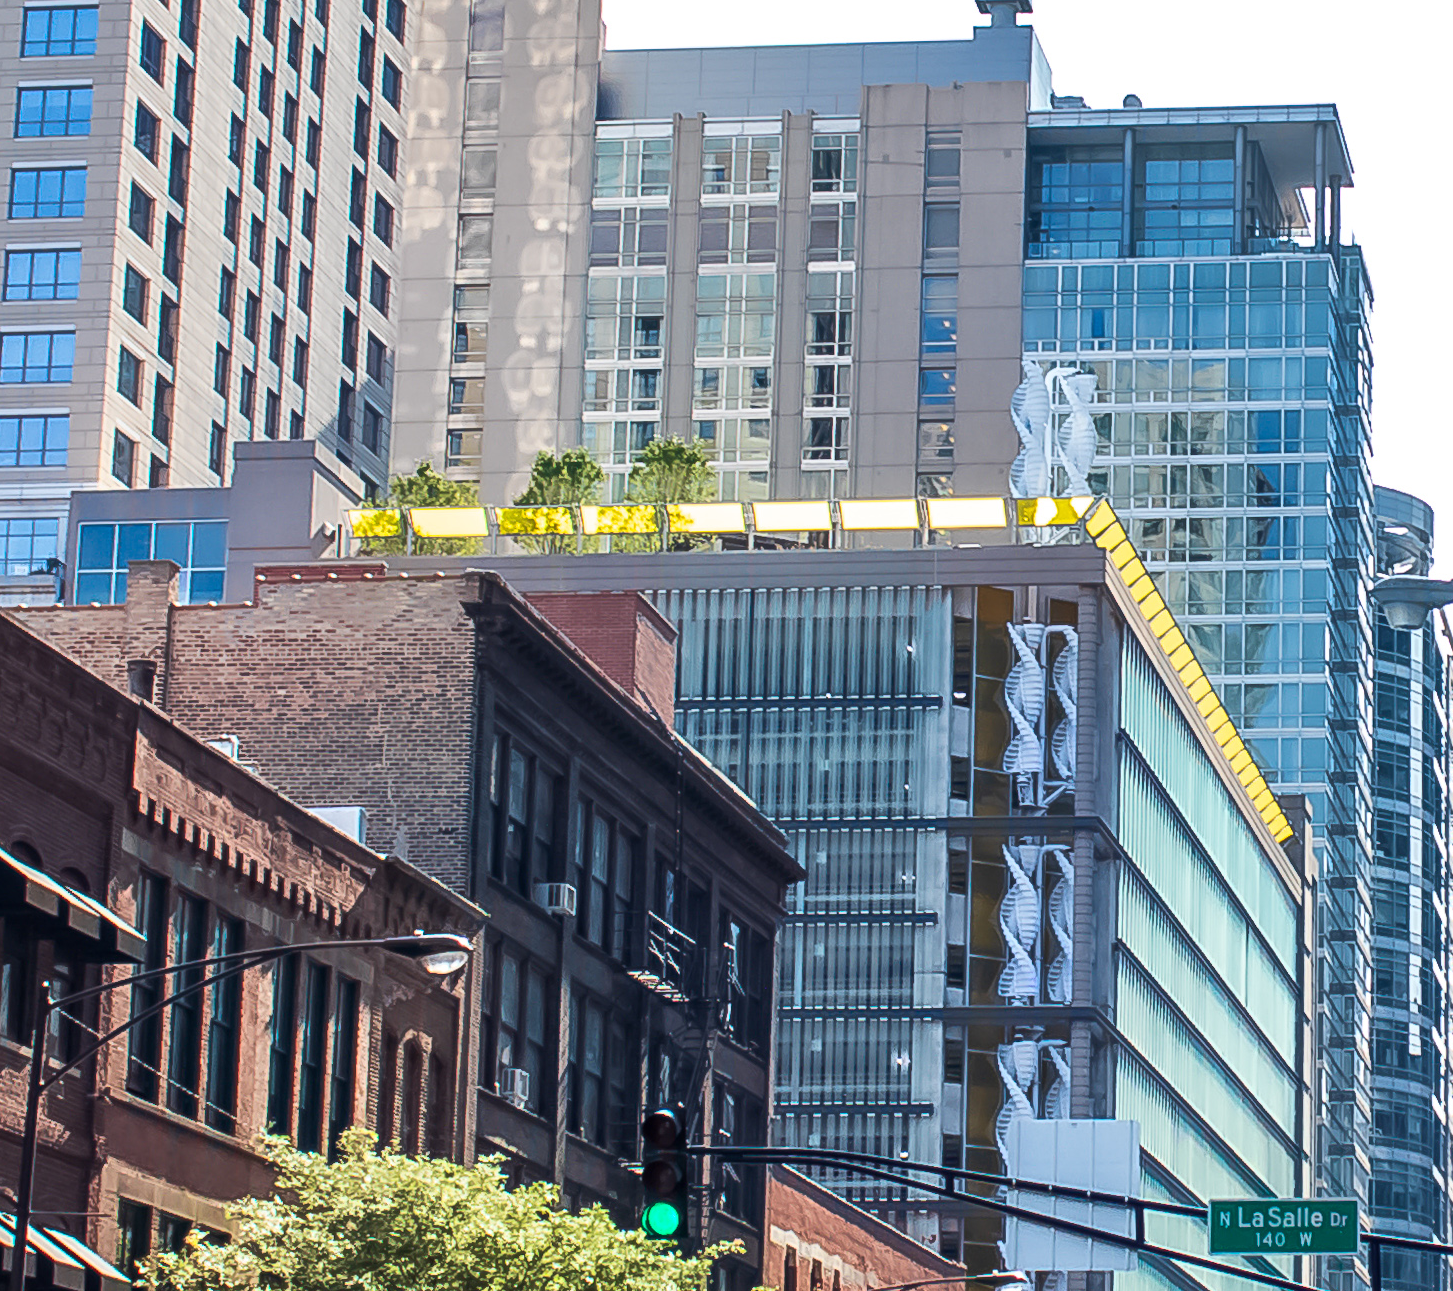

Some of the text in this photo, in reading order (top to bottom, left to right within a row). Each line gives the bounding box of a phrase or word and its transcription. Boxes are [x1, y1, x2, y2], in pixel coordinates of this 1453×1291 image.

[1219, 1211, 1231, 1228] N
[1330, 1212, 1348, 1227] Dr
[1255, 1232, 1313, 1247] 140 W
